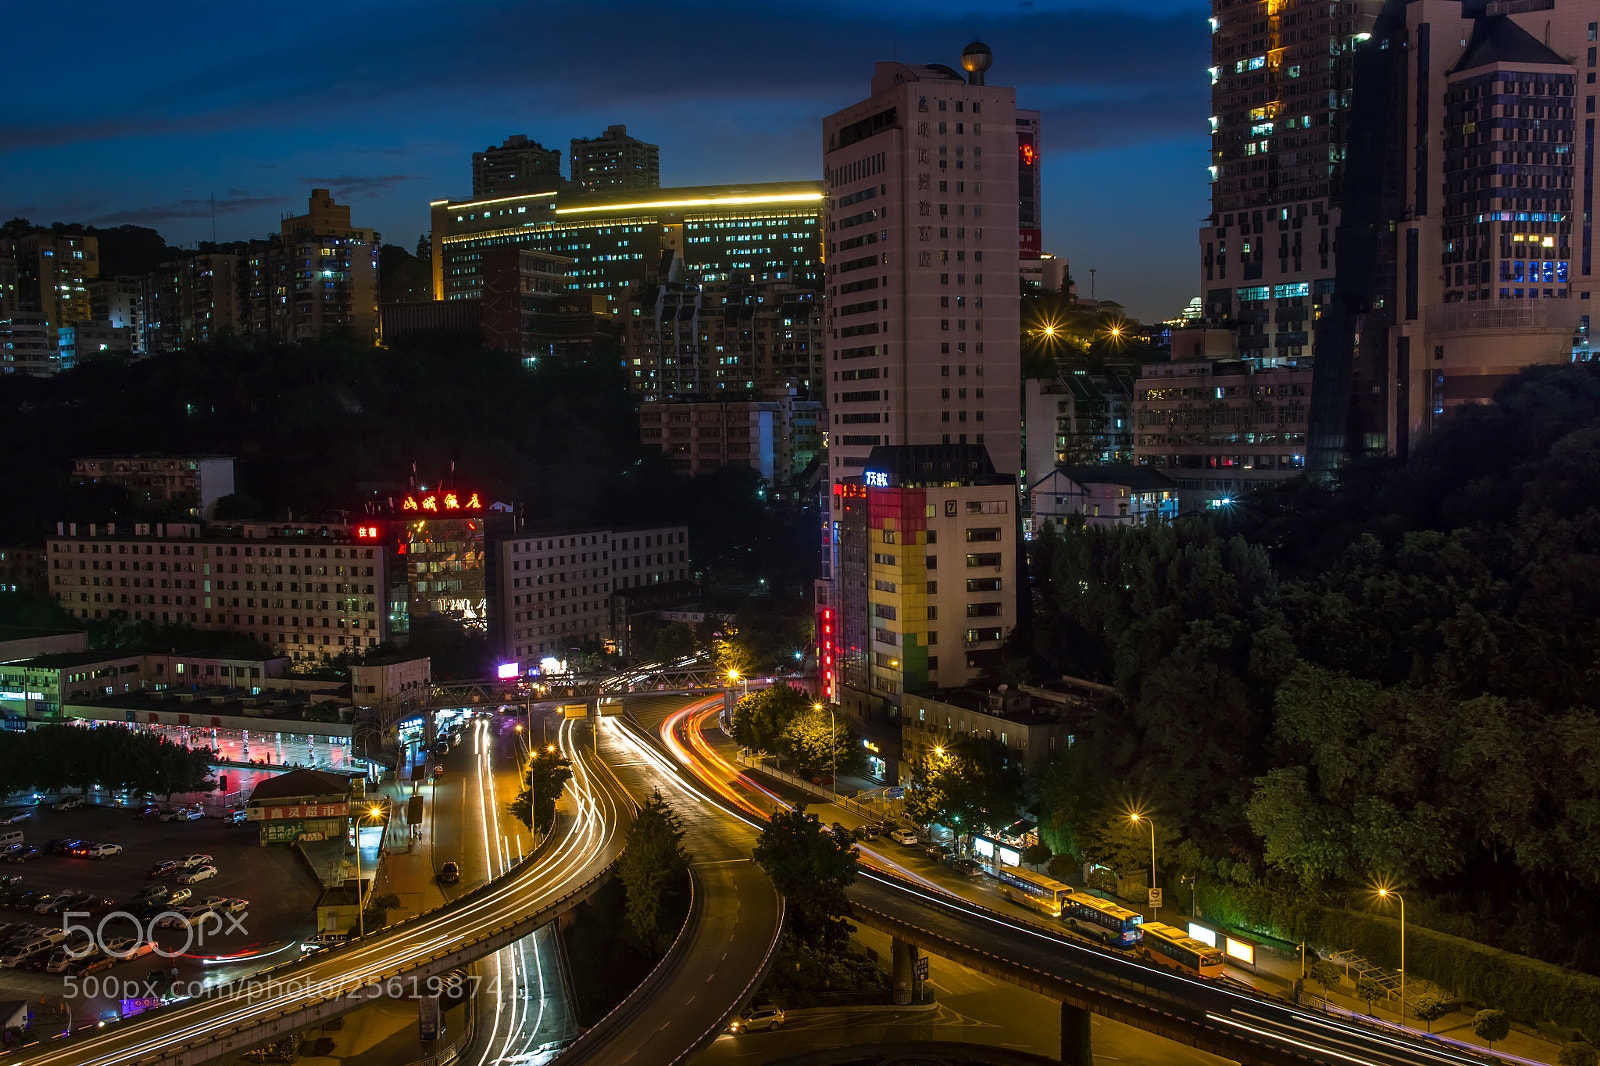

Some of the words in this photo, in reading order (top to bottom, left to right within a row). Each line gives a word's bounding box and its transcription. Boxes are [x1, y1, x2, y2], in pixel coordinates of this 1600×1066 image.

[403, 493, 482, 512] 山城饭店
[358, 526, 377, 538] 住宿
[271, 806, 335, 818] 鑫灵超市
